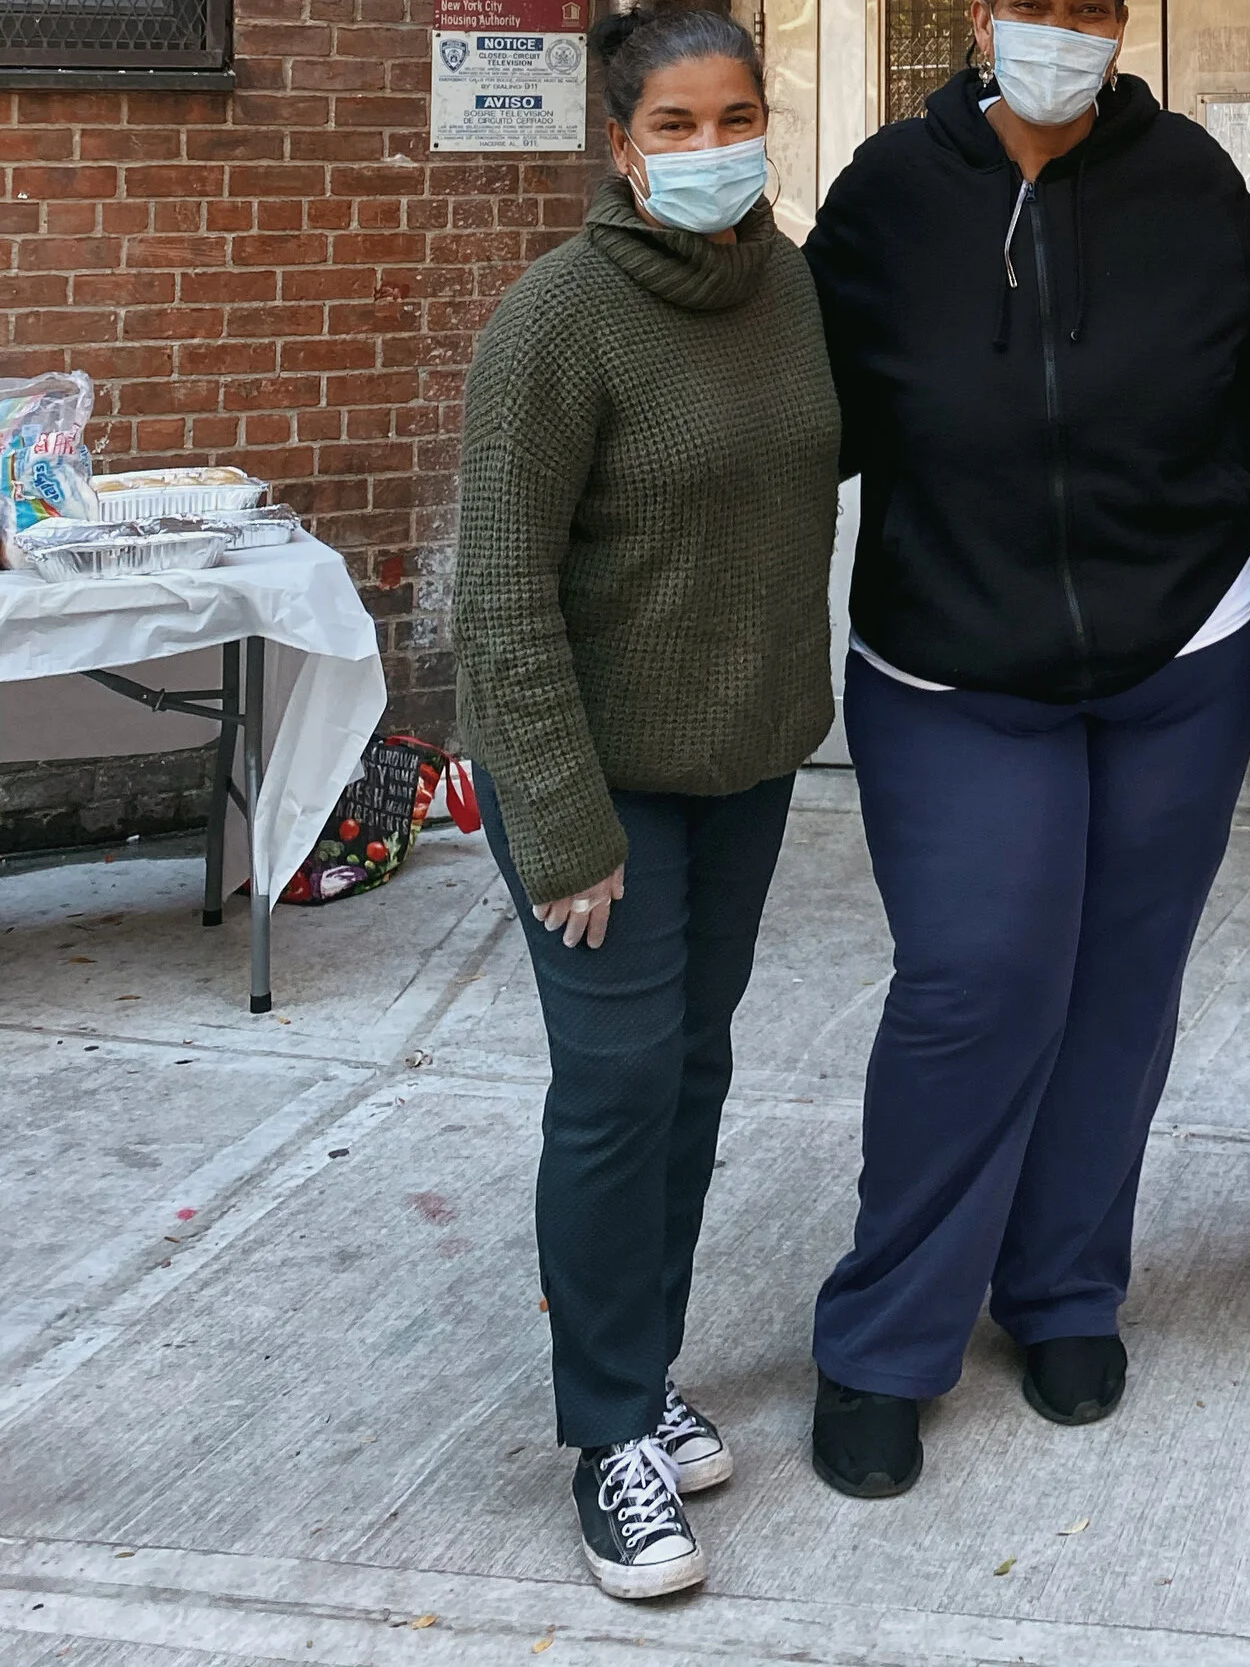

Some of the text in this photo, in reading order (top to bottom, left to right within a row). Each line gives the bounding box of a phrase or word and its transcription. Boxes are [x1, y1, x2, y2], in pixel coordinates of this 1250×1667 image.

[441, 0, 503, 14] New York City
[441, 13, 521, 28] Housing Authority
[484, 38, 536, 50] NOTICE
[484, 97, 535, 108] AVISO
[388, 783, 415, 800] MADE
